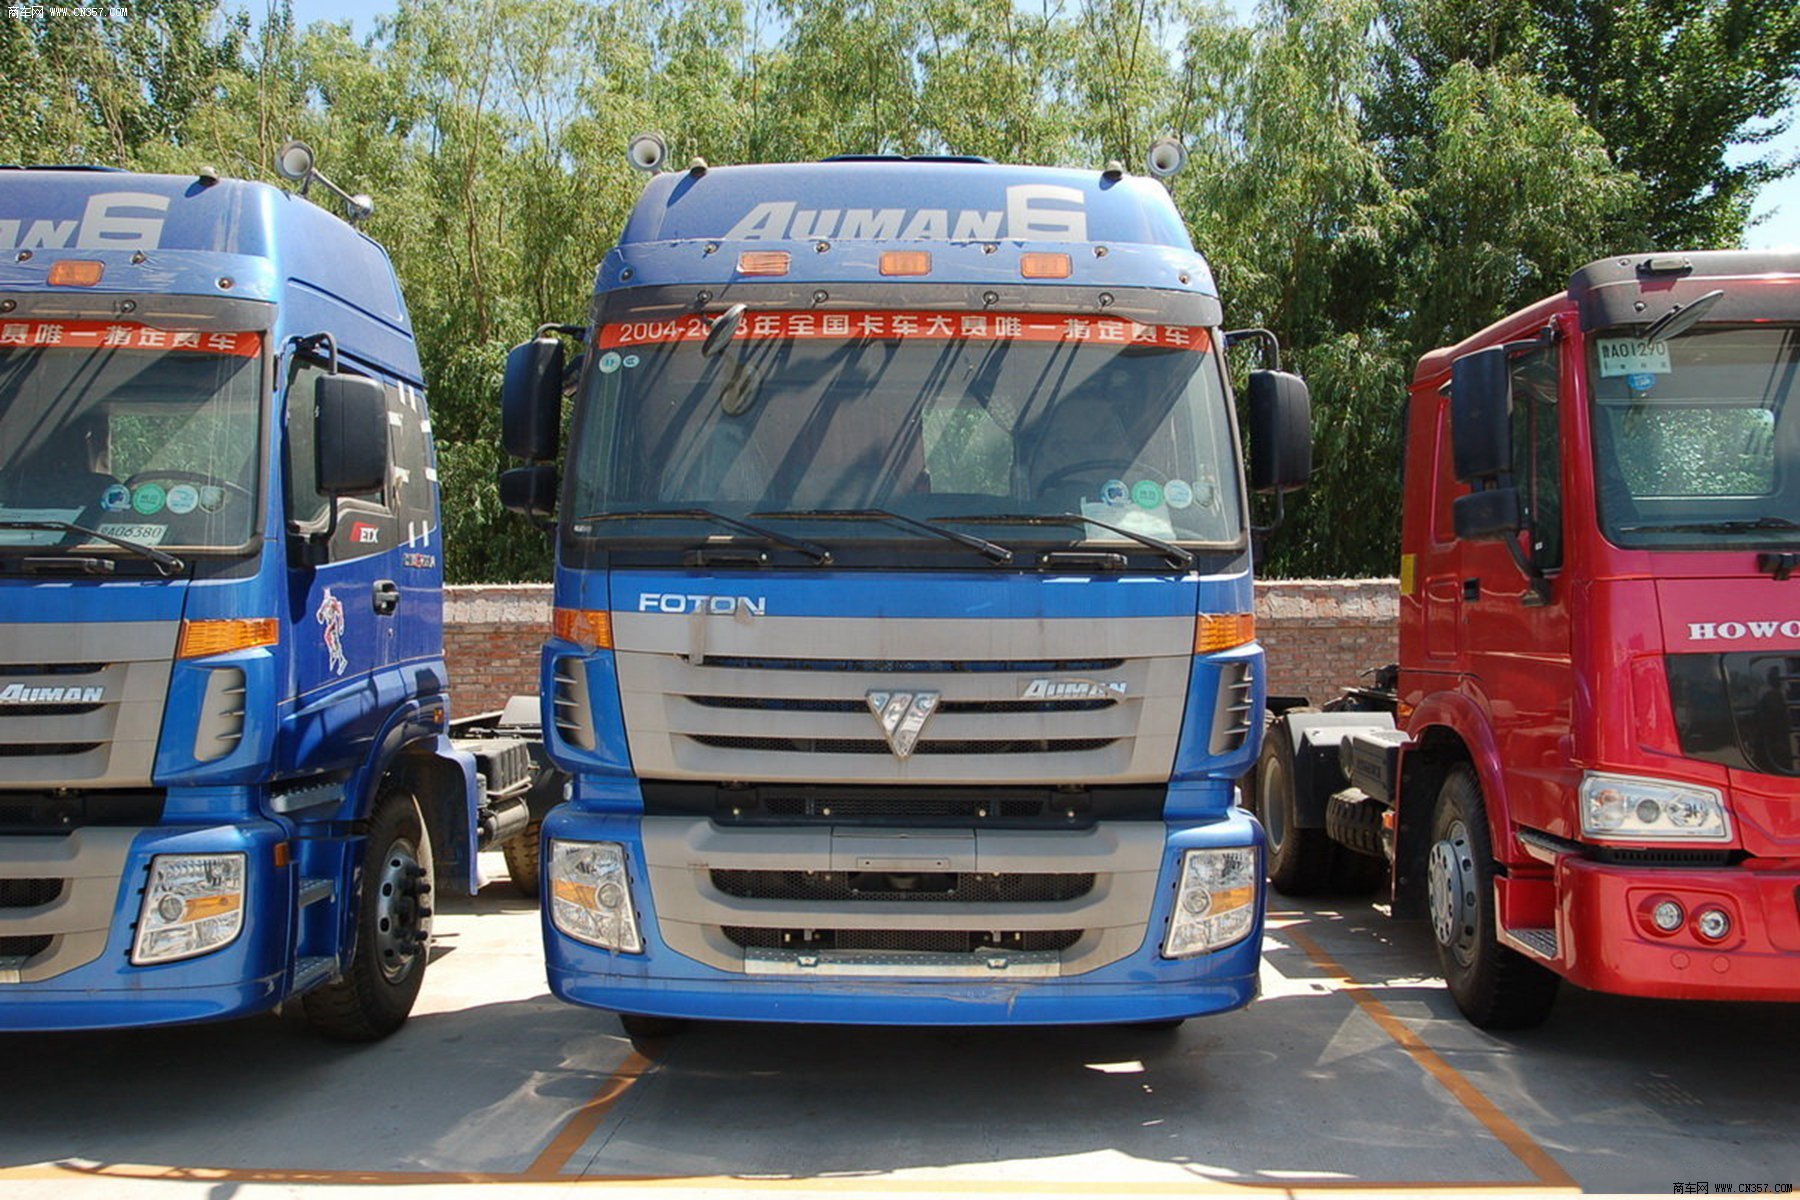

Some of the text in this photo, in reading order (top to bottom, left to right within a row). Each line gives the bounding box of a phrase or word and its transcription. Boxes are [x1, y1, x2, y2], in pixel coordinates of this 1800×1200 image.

[639, 593, 766, 615] FOTON
[1687, 620, 1800, 640] HOWO
[0, 683, 104, 703] AUMAN
